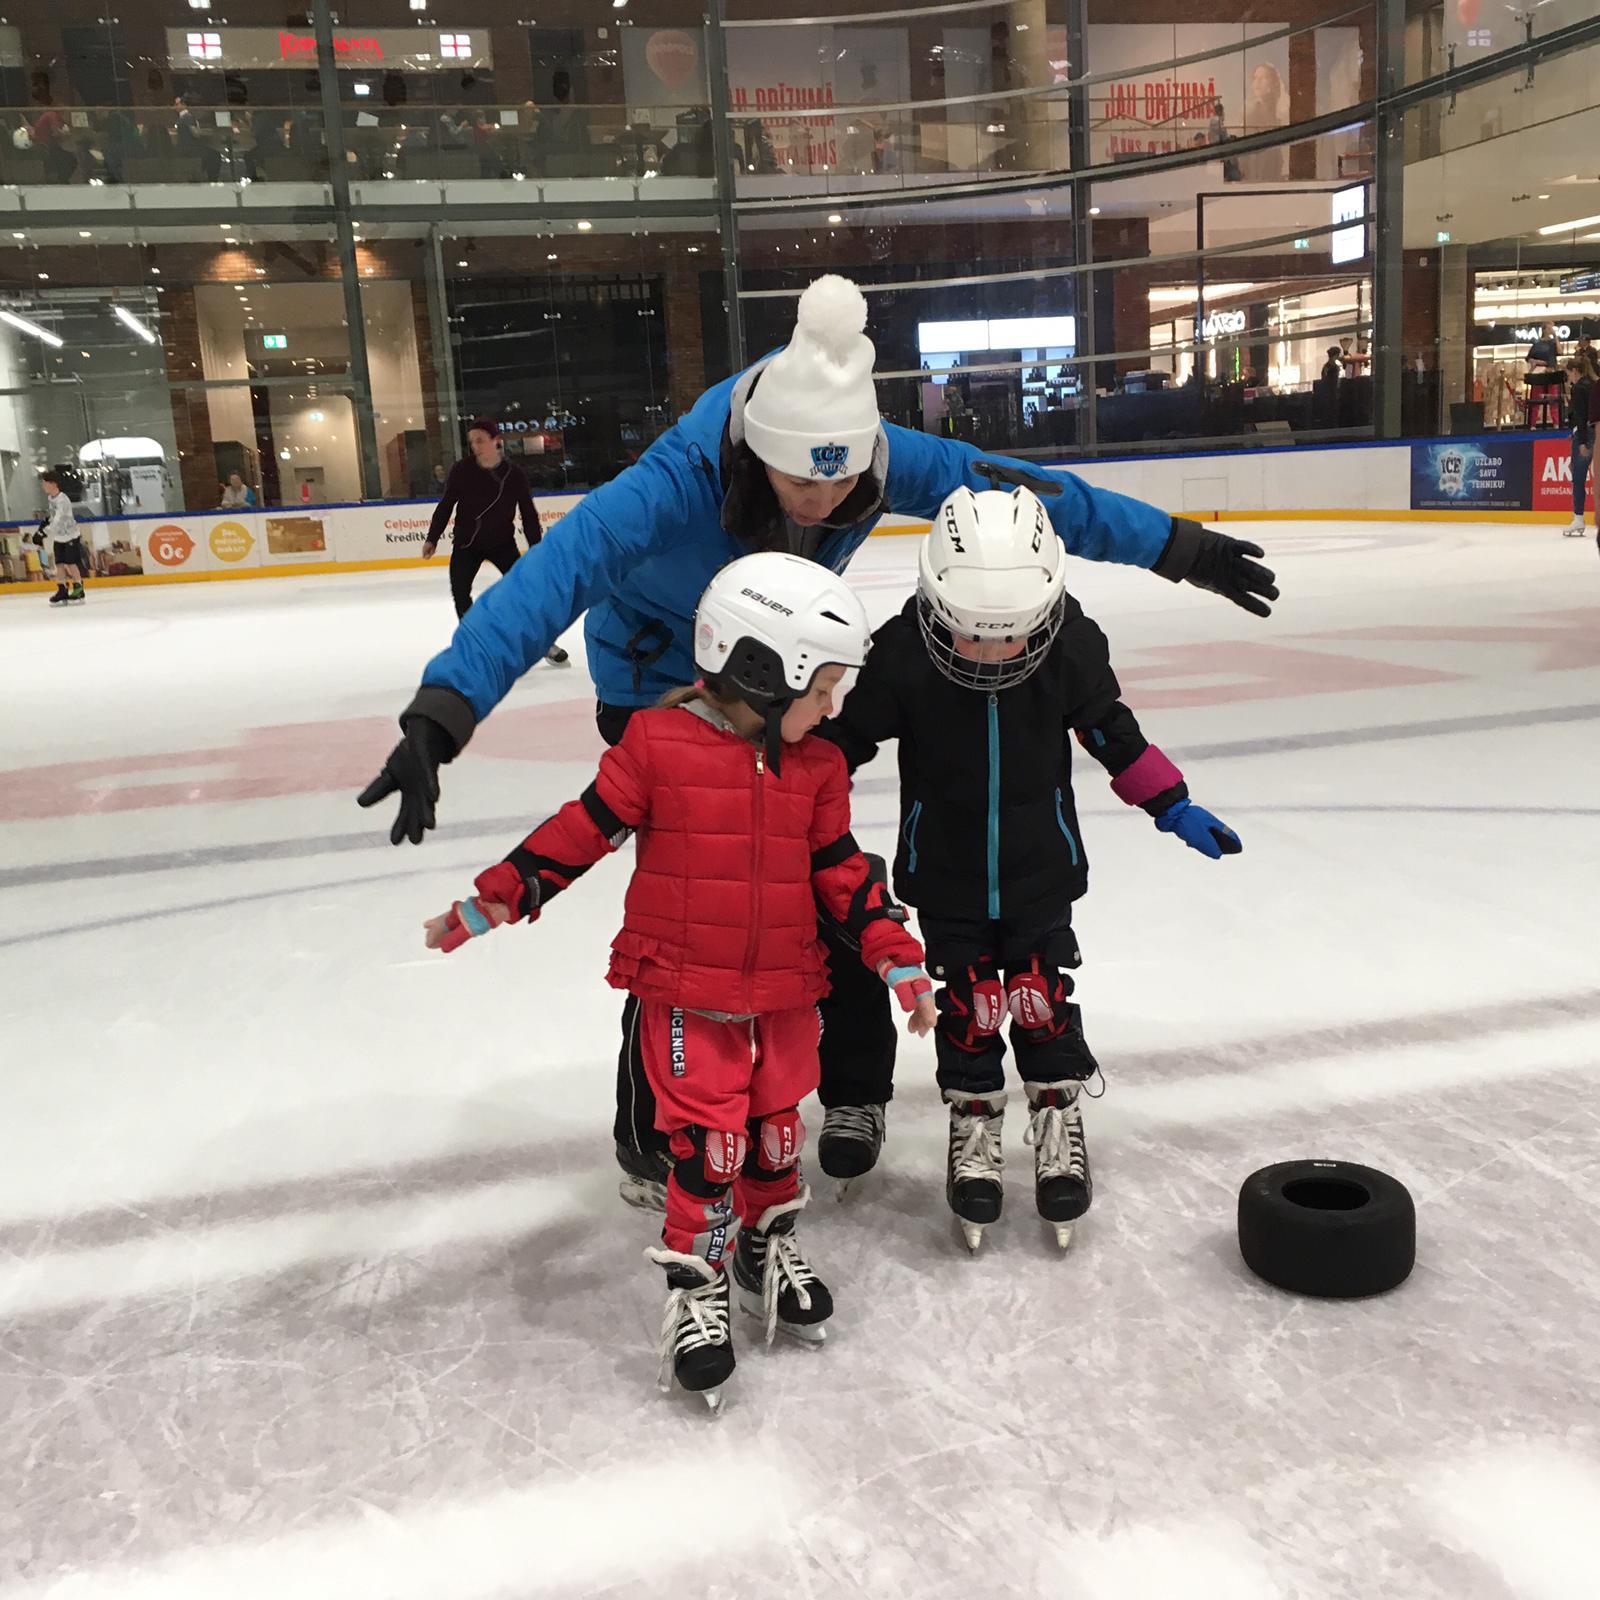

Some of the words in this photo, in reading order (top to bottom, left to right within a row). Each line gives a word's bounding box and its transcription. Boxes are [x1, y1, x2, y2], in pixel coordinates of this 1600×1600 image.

[1514, 324, 1571, 341] MAO
[1474, 457, 1503, 467] UZLABO
[1479, 470, 1497, 478] SAVU
[944, 504, 966, 554] CCM
[740, 587, 794, 617] BAUER
[975, 621, 1016, 630] CCM
[1021, 985, 1036, 1023] CCM
[724, 1132, 735, 1174] CCM
